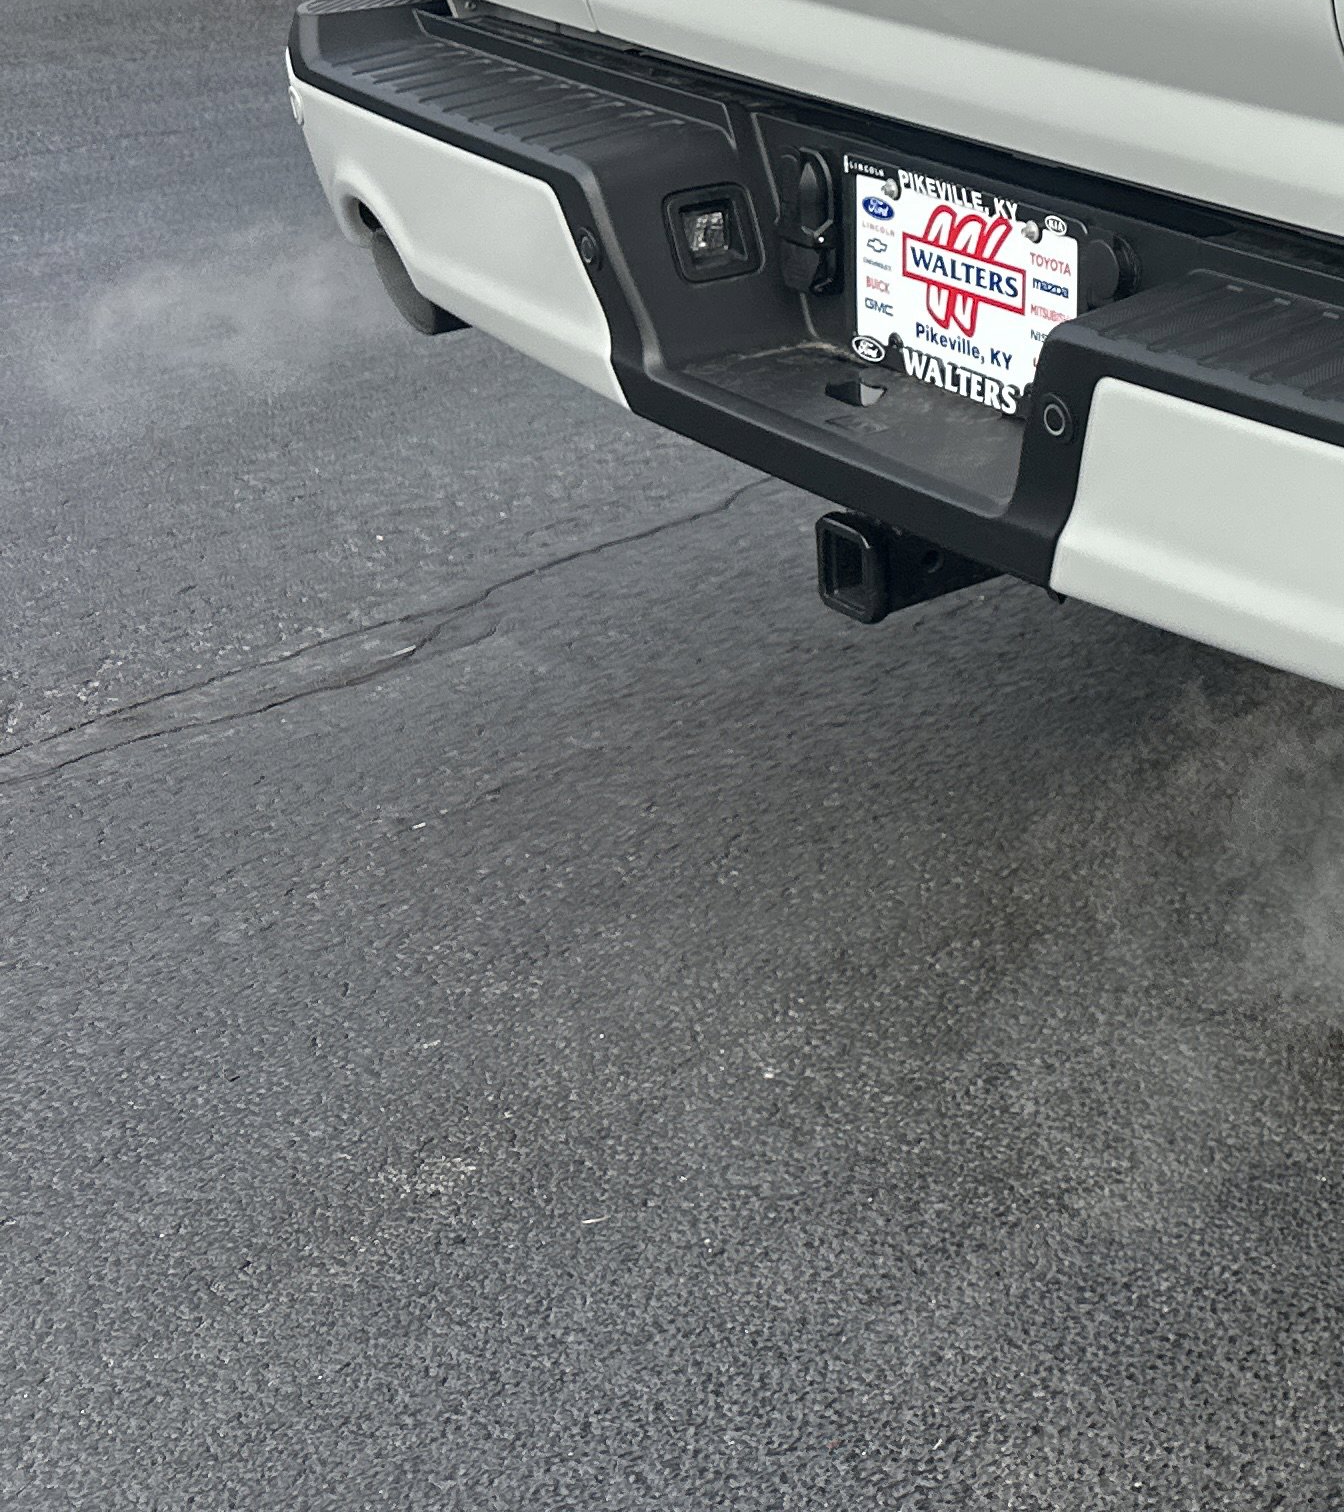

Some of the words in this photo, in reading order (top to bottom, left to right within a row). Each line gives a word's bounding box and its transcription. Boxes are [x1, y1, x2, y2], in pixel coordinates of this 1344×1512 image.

[866, 197, 891, 218] Ford
[898, 169, 990, 217] PIKEVILLE,
[993, 197, 1018, 221] KY
[910, 246, 1018, 298] WALTERS
[1029, 252, 1072, 277] TOYOTA
[864, 297, 894, 317] GMC
[915, 322, 985, 364] Pikeville,
[990, 348, 1013, 371] KY
[903, 347, 1017, 415] WALTERS
